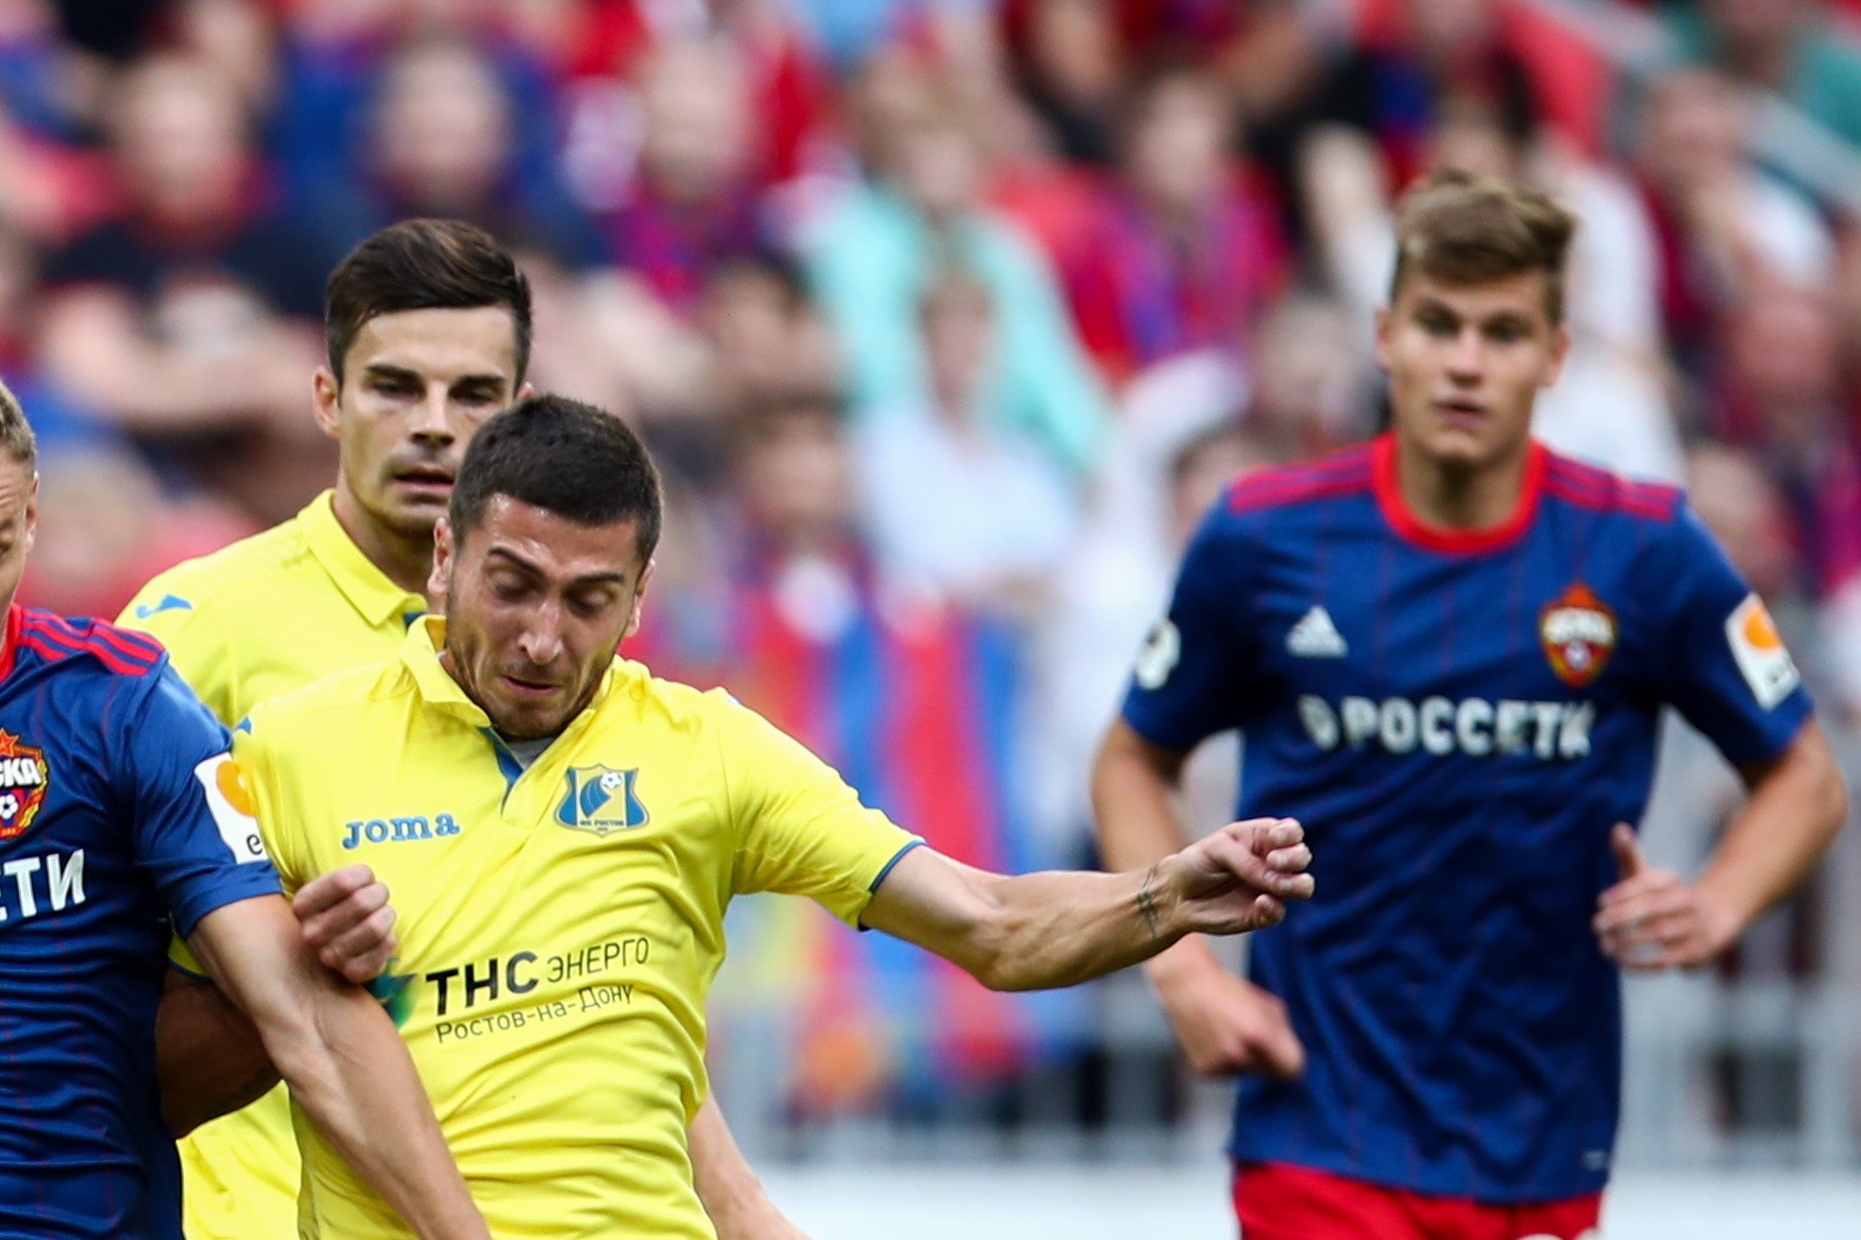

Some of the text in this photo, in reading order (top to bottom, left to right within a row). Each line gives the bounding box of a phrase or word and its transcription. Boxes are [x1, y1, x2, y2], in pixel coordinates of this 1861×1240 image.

[1342, 695, 1595, 759] РОССЕТИ
[341, 813, 460, 850] Joma
[425, 937, 650, 1017] ТНС ЭНЕРГО
[436, 984, 635, 1044] Ростов-на-Дону
